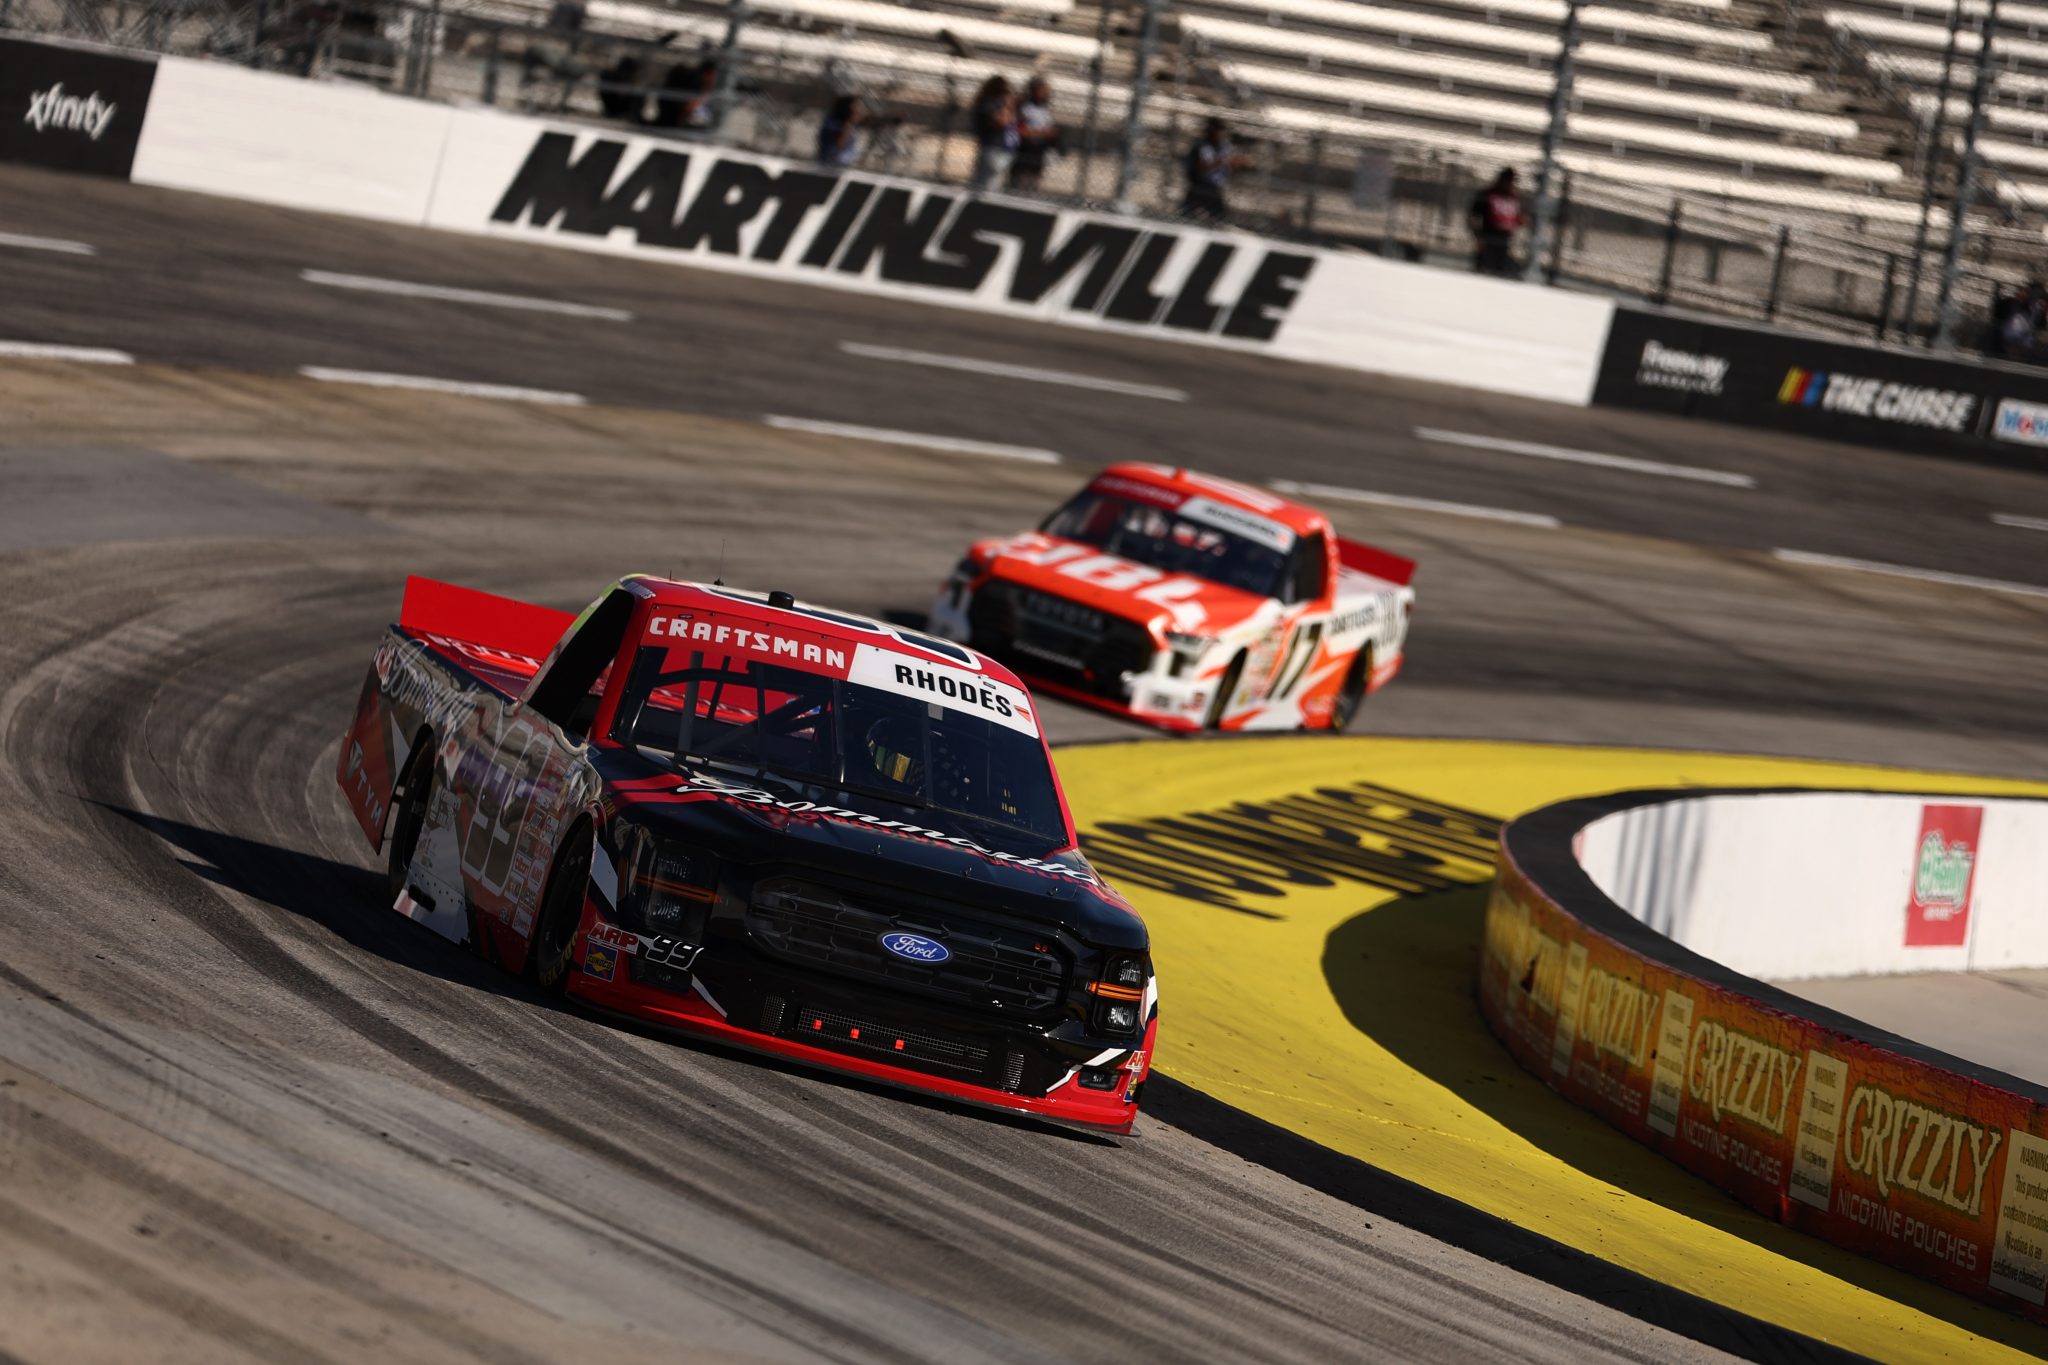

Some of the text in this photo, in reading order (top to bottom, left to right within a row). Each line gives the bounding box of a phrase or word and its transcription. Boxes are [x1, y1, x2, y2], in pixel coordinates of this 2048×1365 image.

[24, 81, 118, 140] xfinity
[490, 130, 1318, 342] MARTINSVILLE
[1821, 371, 1977, 431] THE CHASE
[649, 616, 845, 669] CRAFTSMAN
[895, 664, 1012, 717] RHODES
[677, 777, 1098, 886] Bommarito
[587, 955, 614, 971] SUNOCO
[590, 924, 639, 950] ARP
[646, 935, 704, 971] 99
[893, 936, 938, 959] Ford
[1689, 1020, 1801, 1135] GRIZZLY
[1681, 1116, 1730, 1161] NICOTINE
[1728, 1138, 1784, 1186] POUCHES
[1844, 1086, 2001, 1216] GRIZZLY
[2015, 1173, 2026, 1195] This
[1837, 1188, 1980, 1272] NICOTINE POUCHES
[2003, 1205, 2026, 1225] contains
[2004, 1230, 2028, 1256] Nicotine
[2034, 1247, 2042, 1260] an
